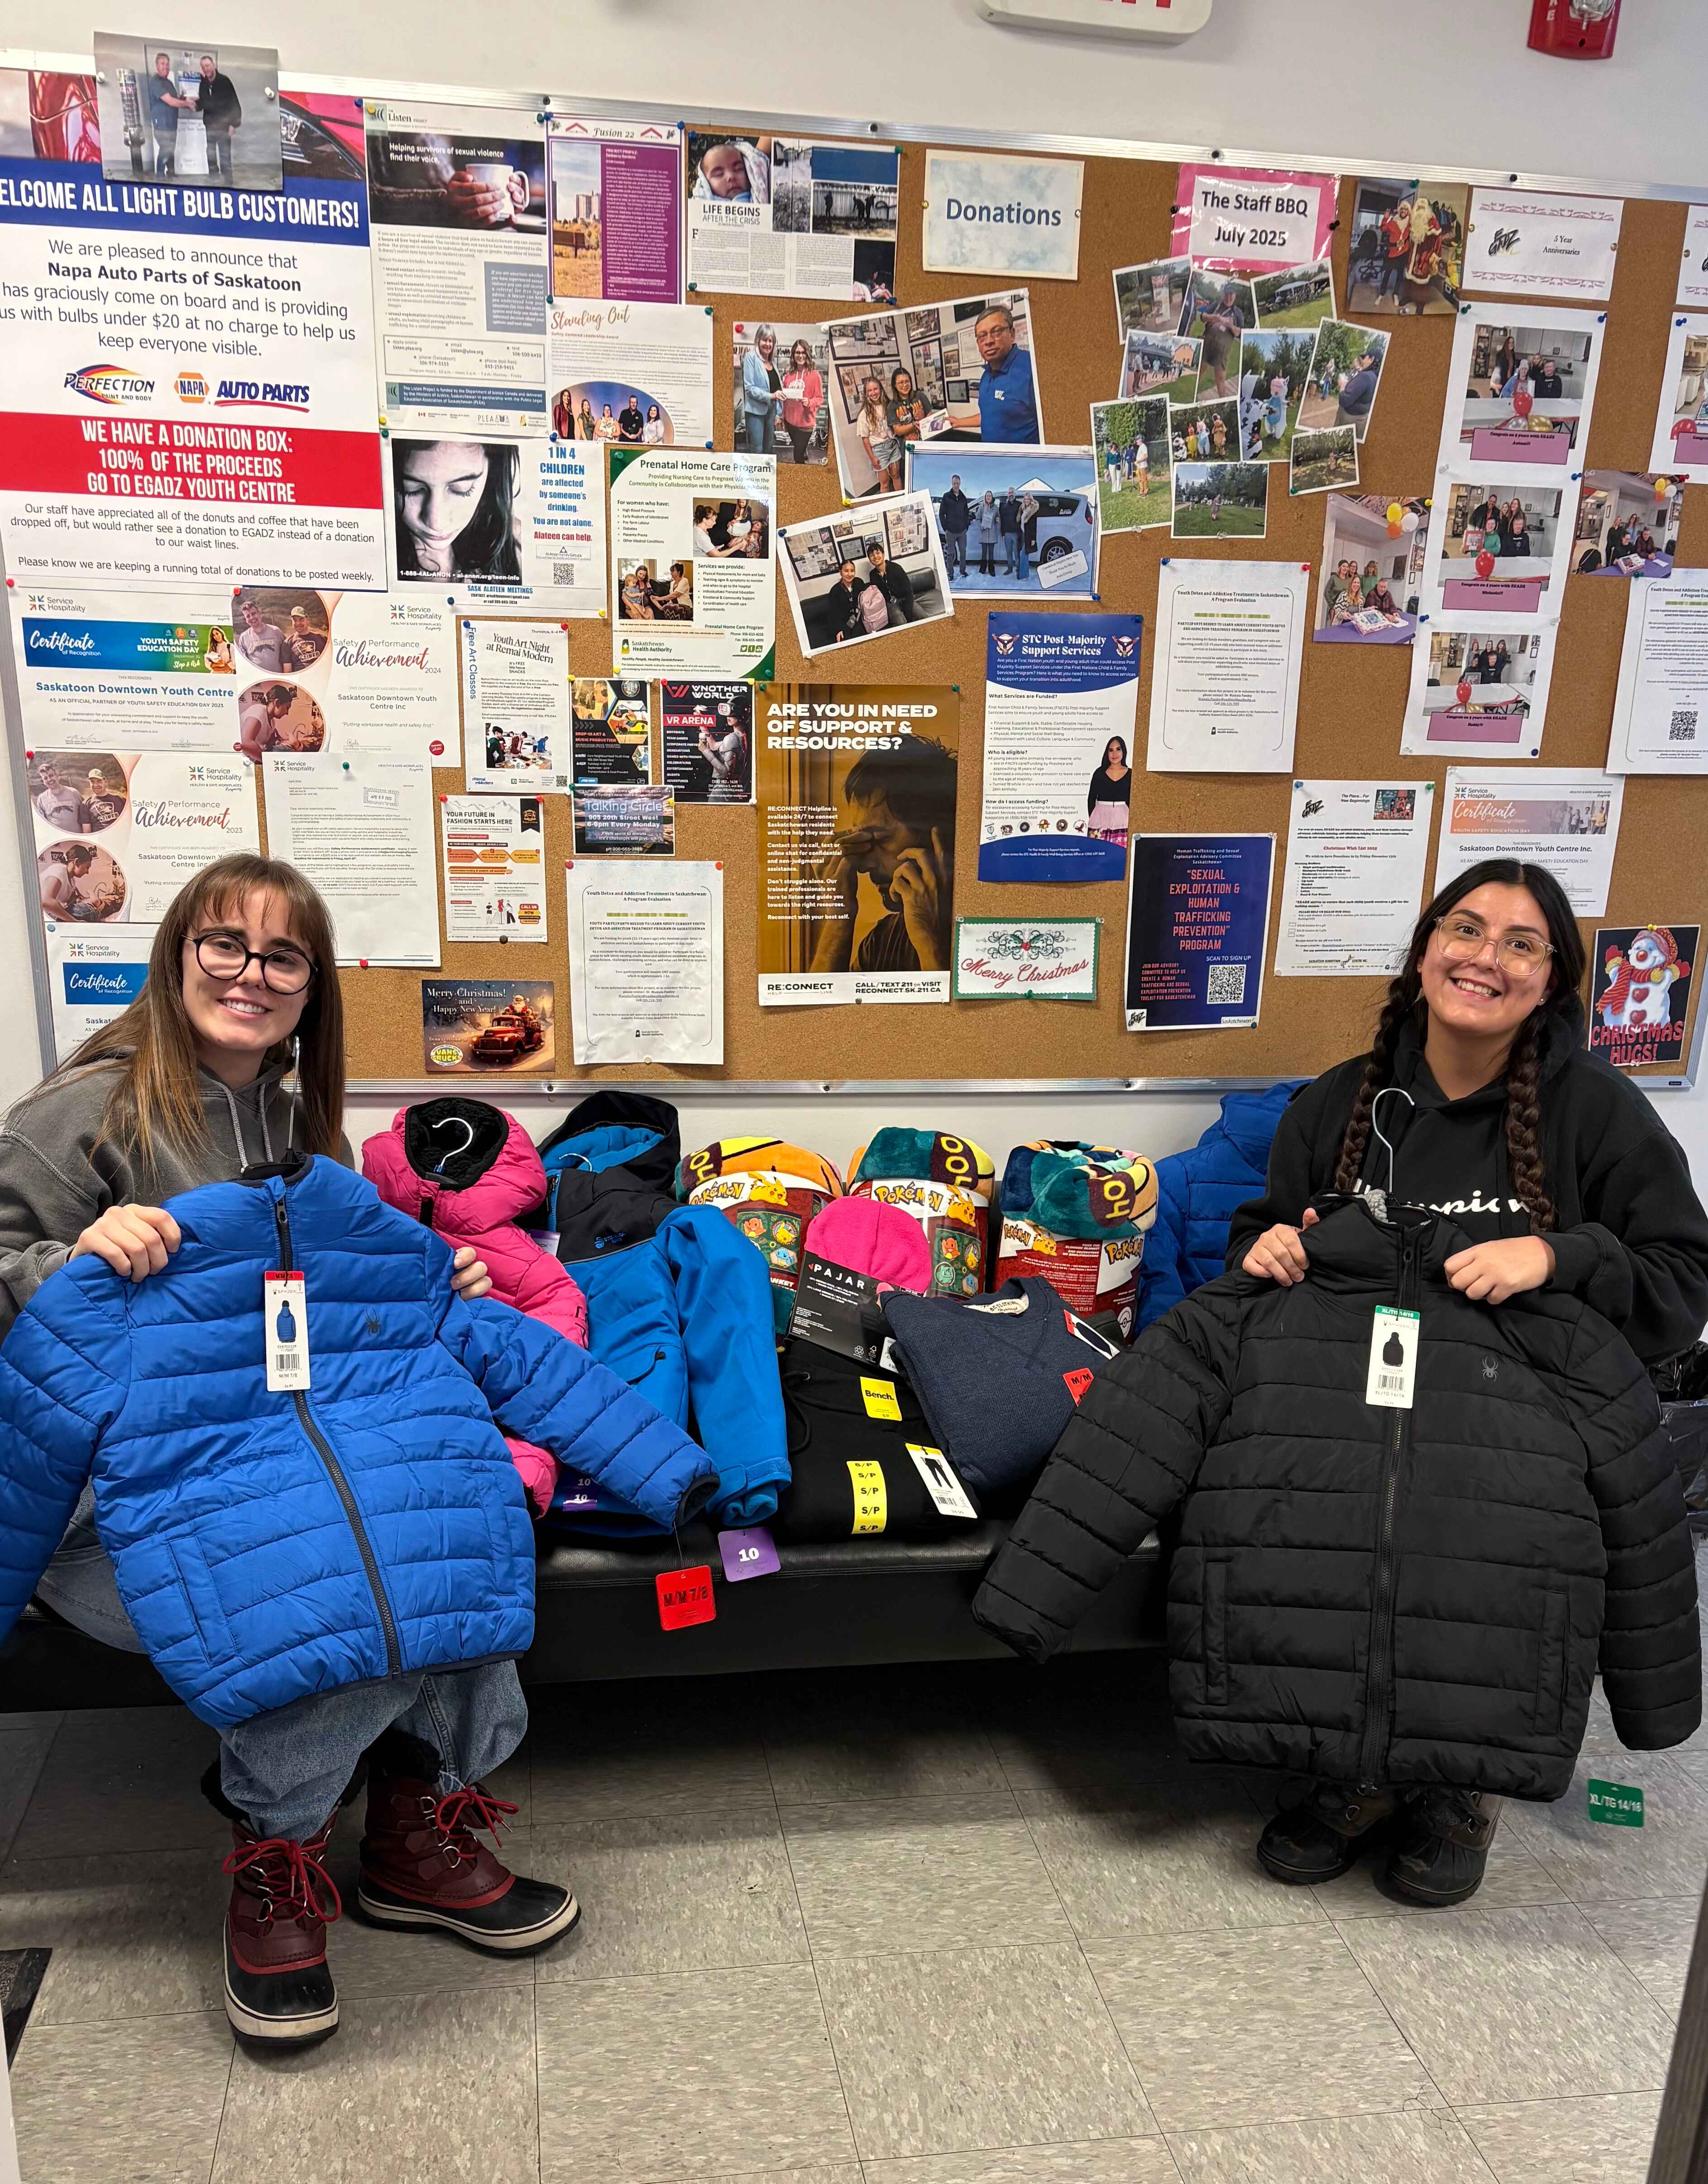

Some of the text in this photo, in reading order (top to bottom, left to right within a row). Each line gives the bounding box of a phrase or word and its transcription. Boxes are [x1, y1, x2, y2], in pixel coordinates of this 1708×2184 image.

[388, 113, 411, 122] Listen
[389, 142, 414, 153] Helping
[477, 148, 503, 157] violence
[0, 178, 358, 227] ELCOME ALL LIGHT BULB CUSTOMERS!
[1202, 191, 1307, 217] The Staff BBQ
[703, 205, 760, 216] LIFE BEGINS
[947, 198, 1060, 225] Donations
[1215, 226, 1285, 246] July 2025
[1543, 246, 1579, 254] Anniversaries
[48, 262, 300, 291] Napa Auto Parts of Saskatoon
[551, 305, 630, 330] Standing Out
[99, 332, 261, 355] keep everyone visible.
[180, 380, 309, 402] NAPA AUTO PARTS
[81, 420, 292, 452] WE HAVE A DONATION BOX:
[548, 446, 575, 459] 1 IN 4
[99, 449, 282, 477] 100% OF THE PROCEEDS
[540, 463, 584, 474] CHILDREN
[641, 460, 772, 473] Prenatal Home Care Program
[88, 472, 295, 502] GO TO EGADZ YOUTH CENTRE
[156, 537, 165, 546] to
[187, 539, 211, 548] waist
[215, 539, 238, 549] lines.
[576, 533, 592, 541] help.
[493, 633, 549, 653] Youth Art Night
[1022, 634, 1105, 647] STC Post-Majority
[336, 641, 429, 670] Achievement
[496, 644, 521, 656] Remai
[522, 649, 553, 663] Modern
[1022, 646, 1101, 656] Support Services
[36, 682, 233, 696] Saskatoon Downtown Youth Centre
[767, 704, 937, 717] ARE YOU IN NEED
[767, 720, 912, 733] OF SUPPORT &
[768, 737, 902, 750] RESOURCES?
[587, 801, 662, 813] Talking Circle
[1170, 883, 1239, 894] EXPLOITATION &
[1188, 897, 1219, 908] HUMAN
[1175, 911, 1230, 922] TRAFFICKING
[1180, 939, 1220, 950] PROGRAM
[962, 958, 1088, 988] Merry Christmas
[427, 987, 505, 999] Merry Christmas!
[433, 1006, 457, 1015] Happy
[1592, 1021, 1684, 1046] CHRISTMAS
[1610, 1044, 1658, 1064] HUGS!
[814, 1264, 865, 1289] PAJAR
[1071, 1373, 1091, 1385] M/M
[865, 1390, 895, 1400] Bench.
[861, 1487, 879, 1496] S/P
[861, 1507, 880, 1515] S/P
[738, 1547, 760, 1562] 10
